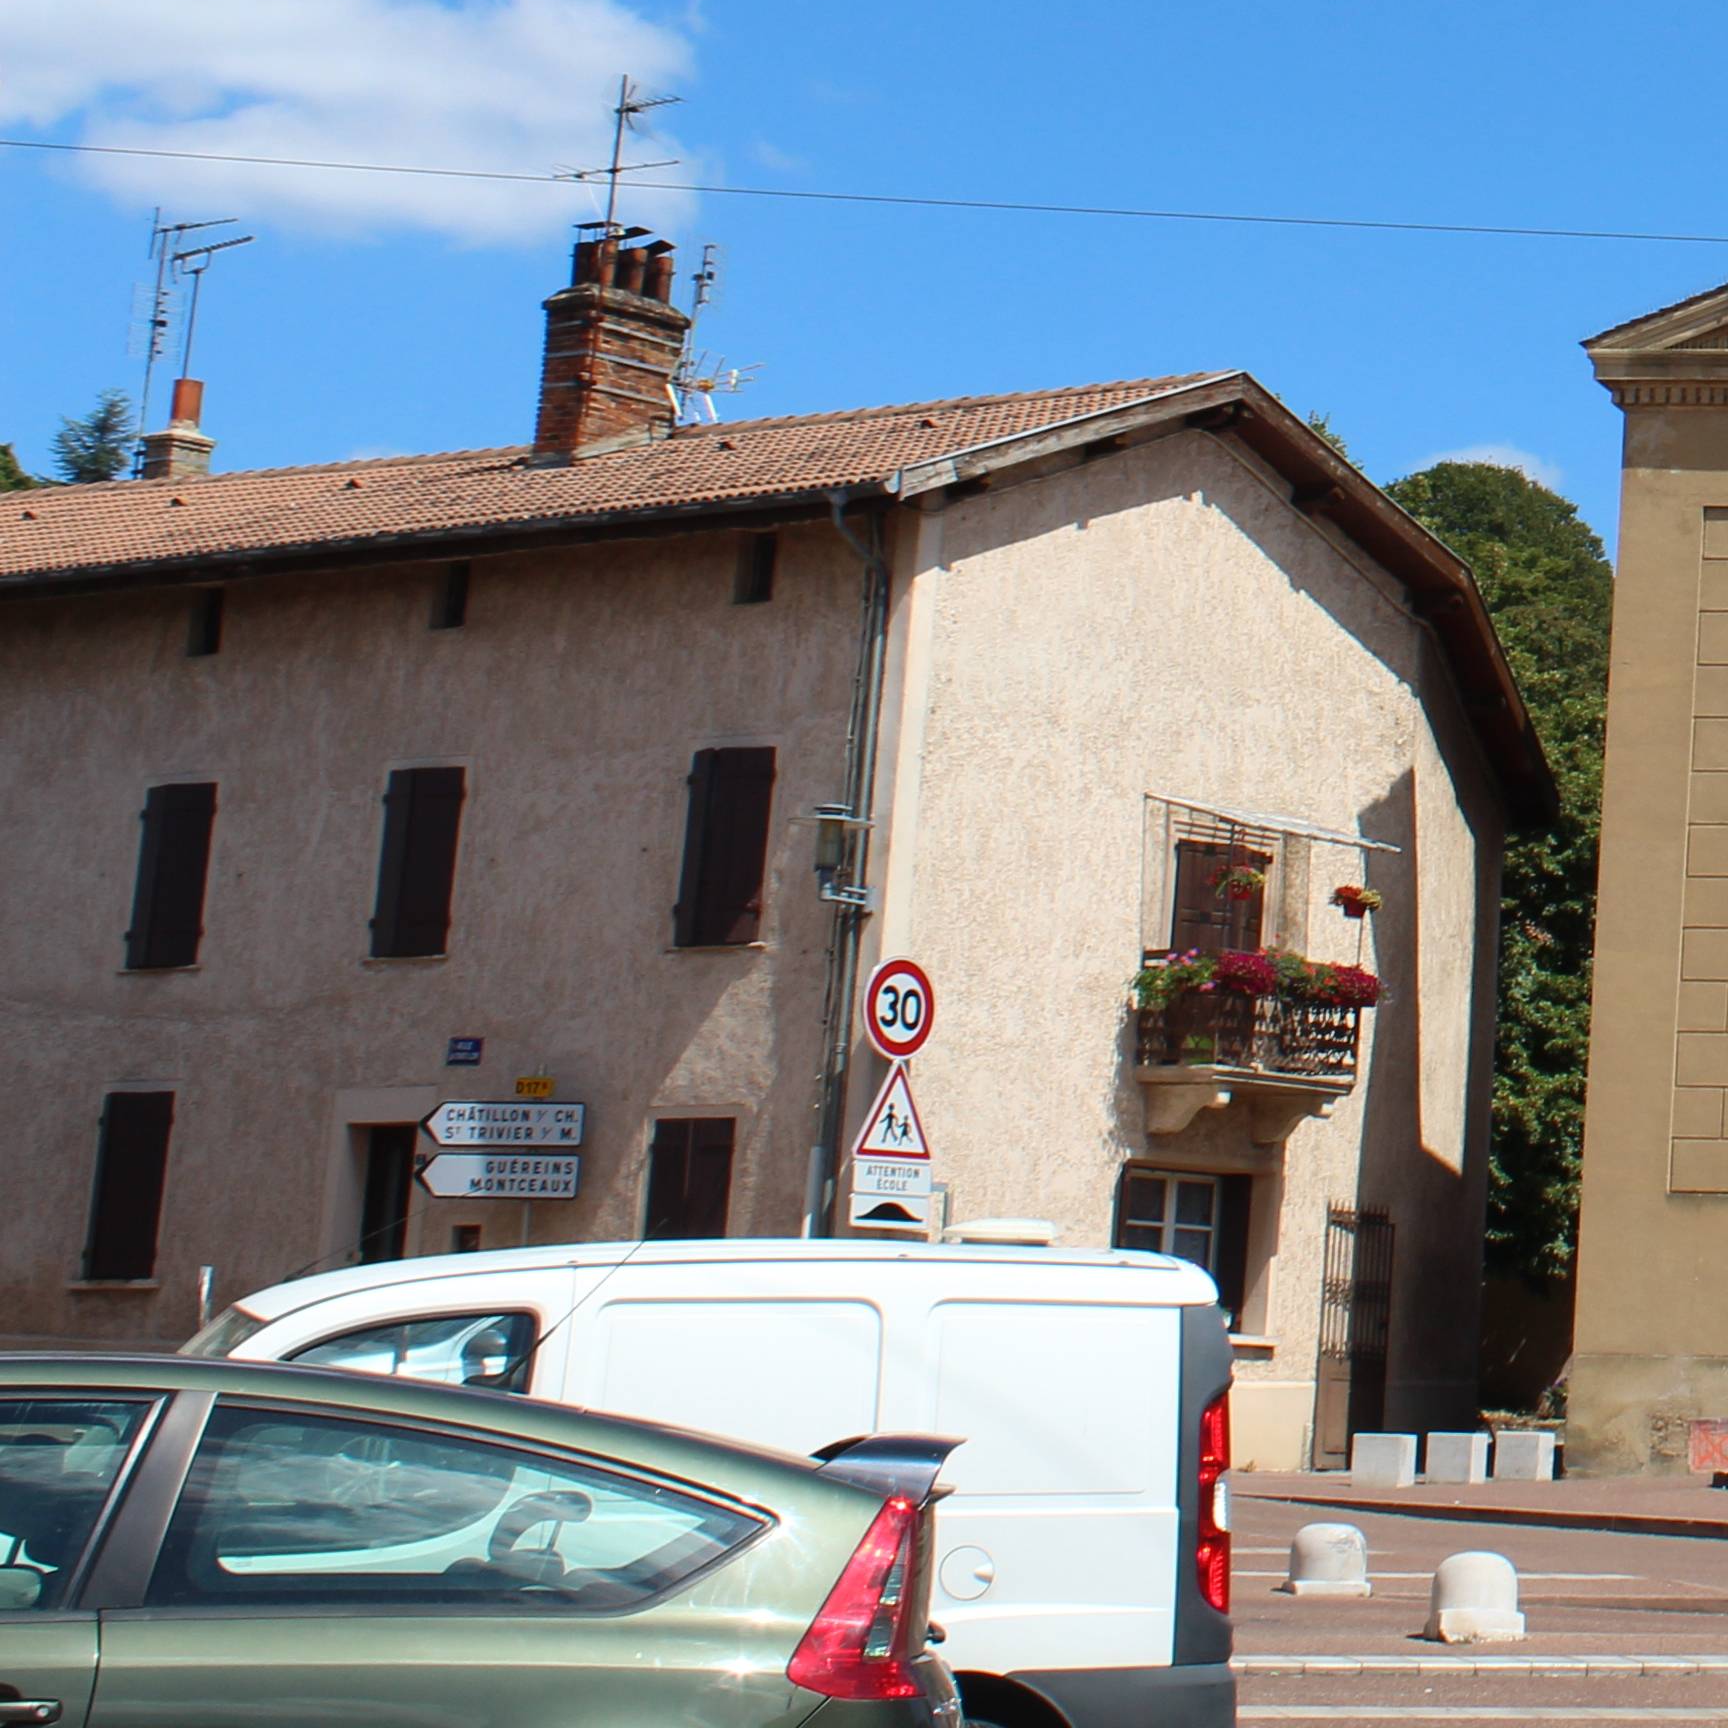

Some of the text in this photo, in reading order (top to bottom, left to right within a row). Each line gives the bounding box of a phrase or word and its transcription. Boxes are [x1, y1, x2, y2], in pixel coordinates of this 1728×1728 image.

[879, 985, 922, 1031] 30
[446, 1106, 531, 1122] CHÂTILLON
[469, 1126, 534, 1140] TRIVIER
[485, 1159, 575, 1174] GUÉREINS
[866, 1165, 920, 1179] ATTENTION
[469, 1178, 573, 1192] MONTCEAUX
